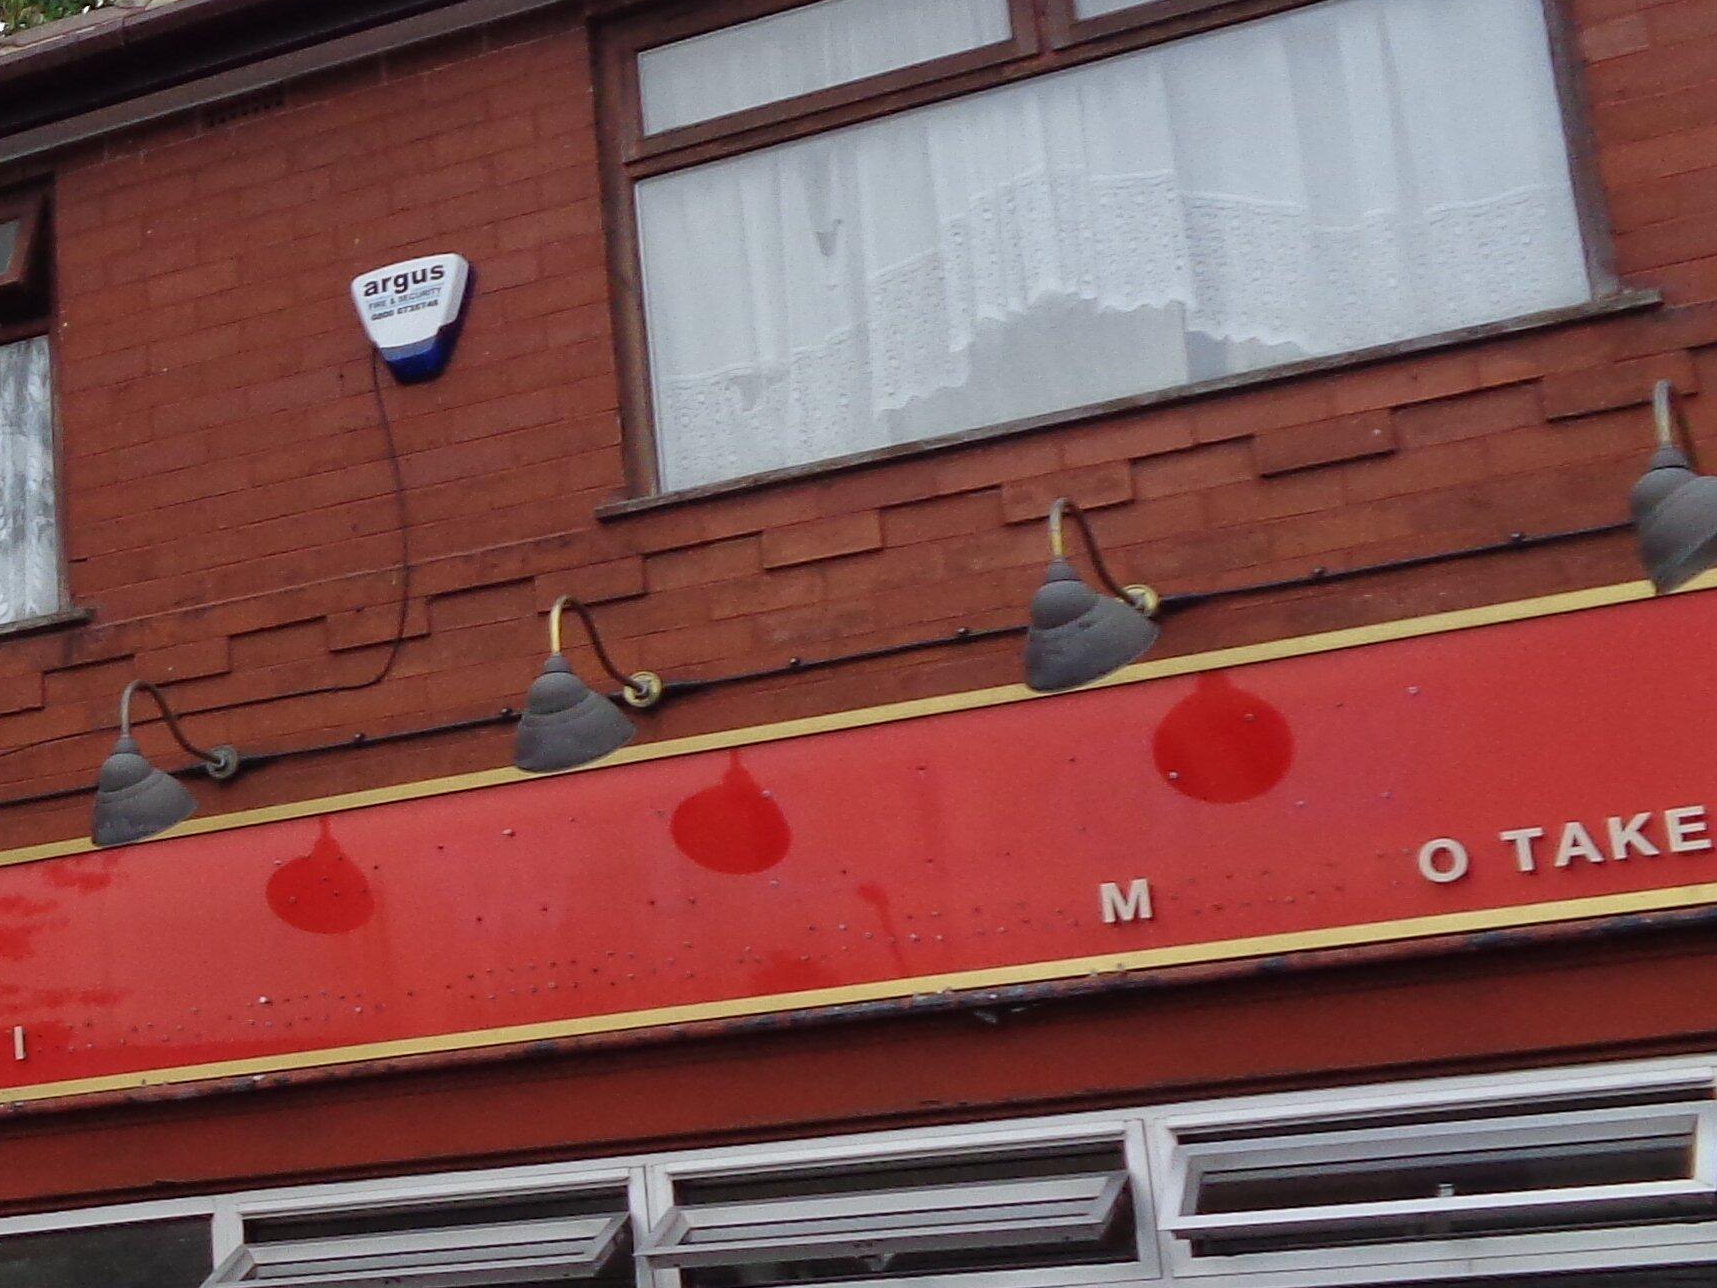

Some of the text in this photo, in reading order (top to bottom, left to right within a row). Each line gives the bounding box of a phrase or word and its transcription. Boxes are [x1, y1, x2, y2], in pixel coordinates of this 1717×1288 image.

[363, 264, 445, 297] argus
[1098, 805, 1714, 925] M O TAKE
